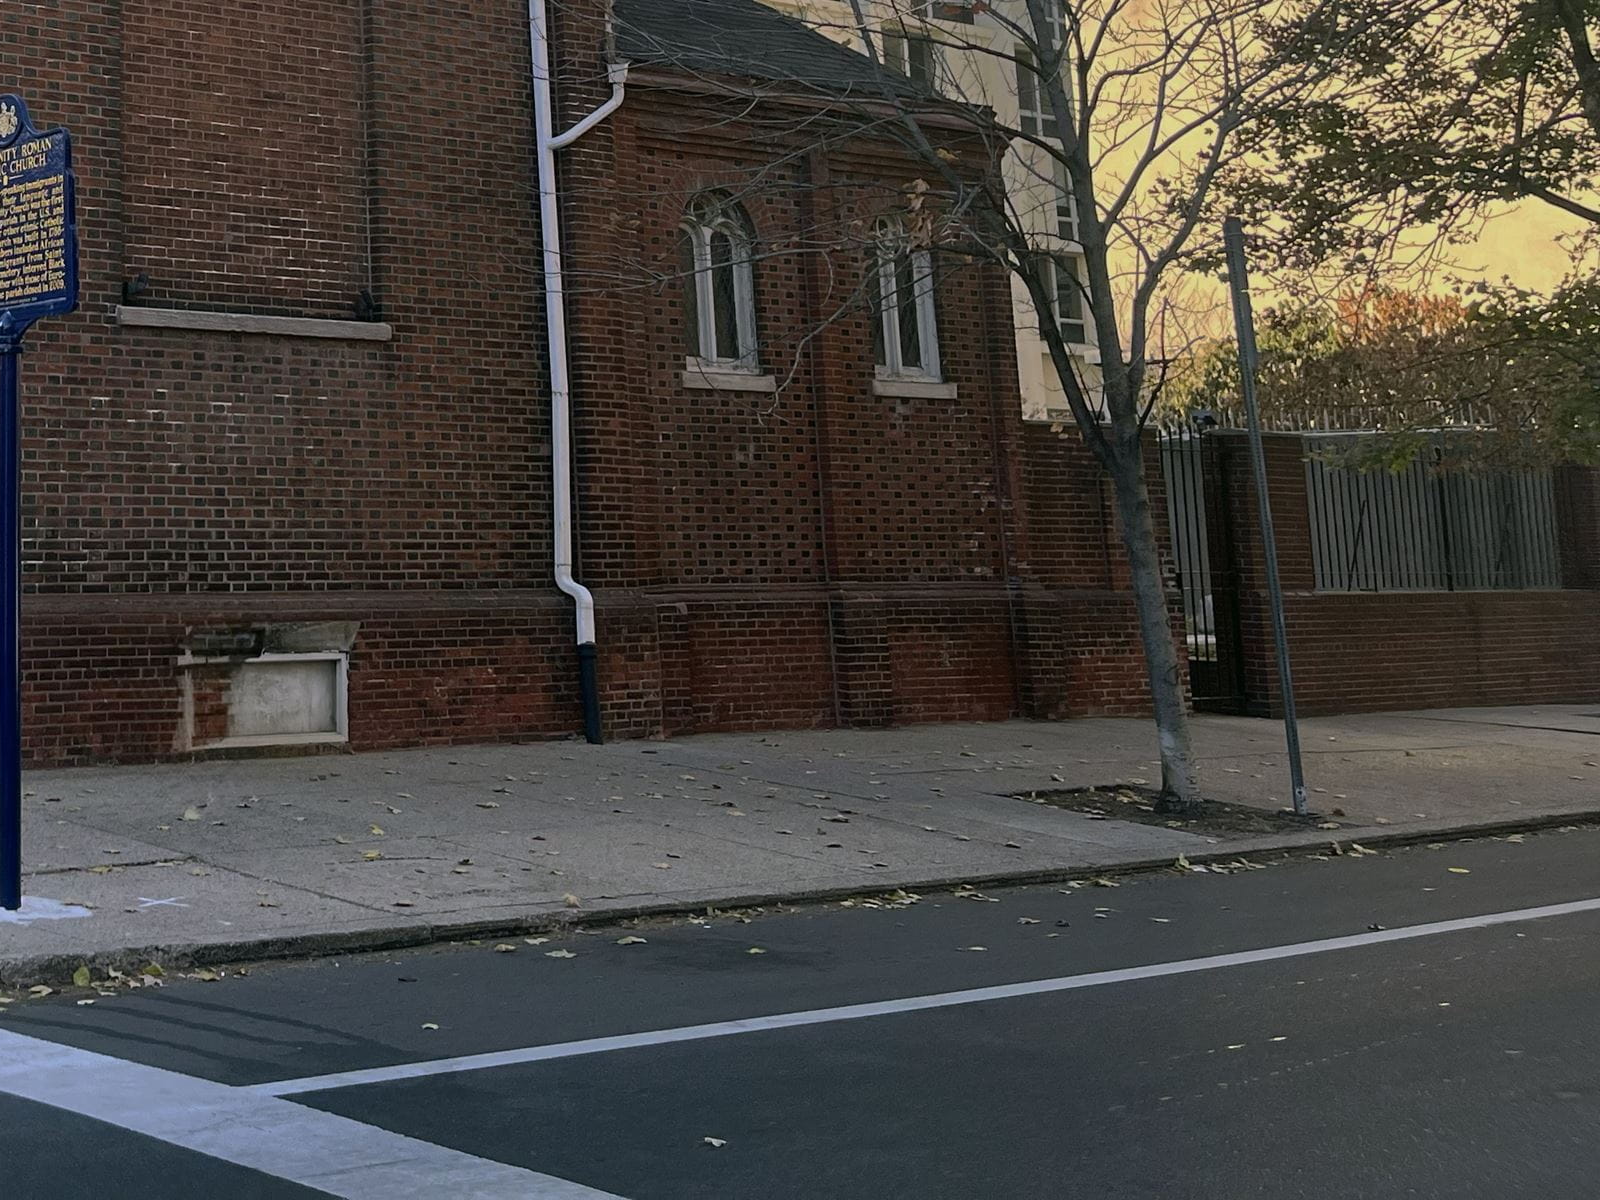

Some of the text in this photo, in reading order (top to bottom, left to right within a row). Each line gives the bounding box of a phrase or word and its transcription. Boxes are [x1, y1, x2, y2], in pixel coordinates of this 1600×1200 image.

[22, 138, 51, 156] ROMAN
[10, 153, 46, 173] CHURCH
[52, 184, 63, 194] and
[10, 204, 29, 214] Church
[0, 216, 18, 228] parish
[20, 213, 26, 222] in
[28, 210, 37, 220] the
[53, 204, 64, 215] and
[3, 225, 20, 236] other
[40, 216, 64, 228] Catholic
[40, 230, 47, 239] in
[40, 237, 64, 249] African
[27, 252, 43, 262] from
[49, 258, 65, 269] Black
[6, 288, 23, 300] parish
[24, 284, 42, 295] closed
[43, 282, 49, 292] in
